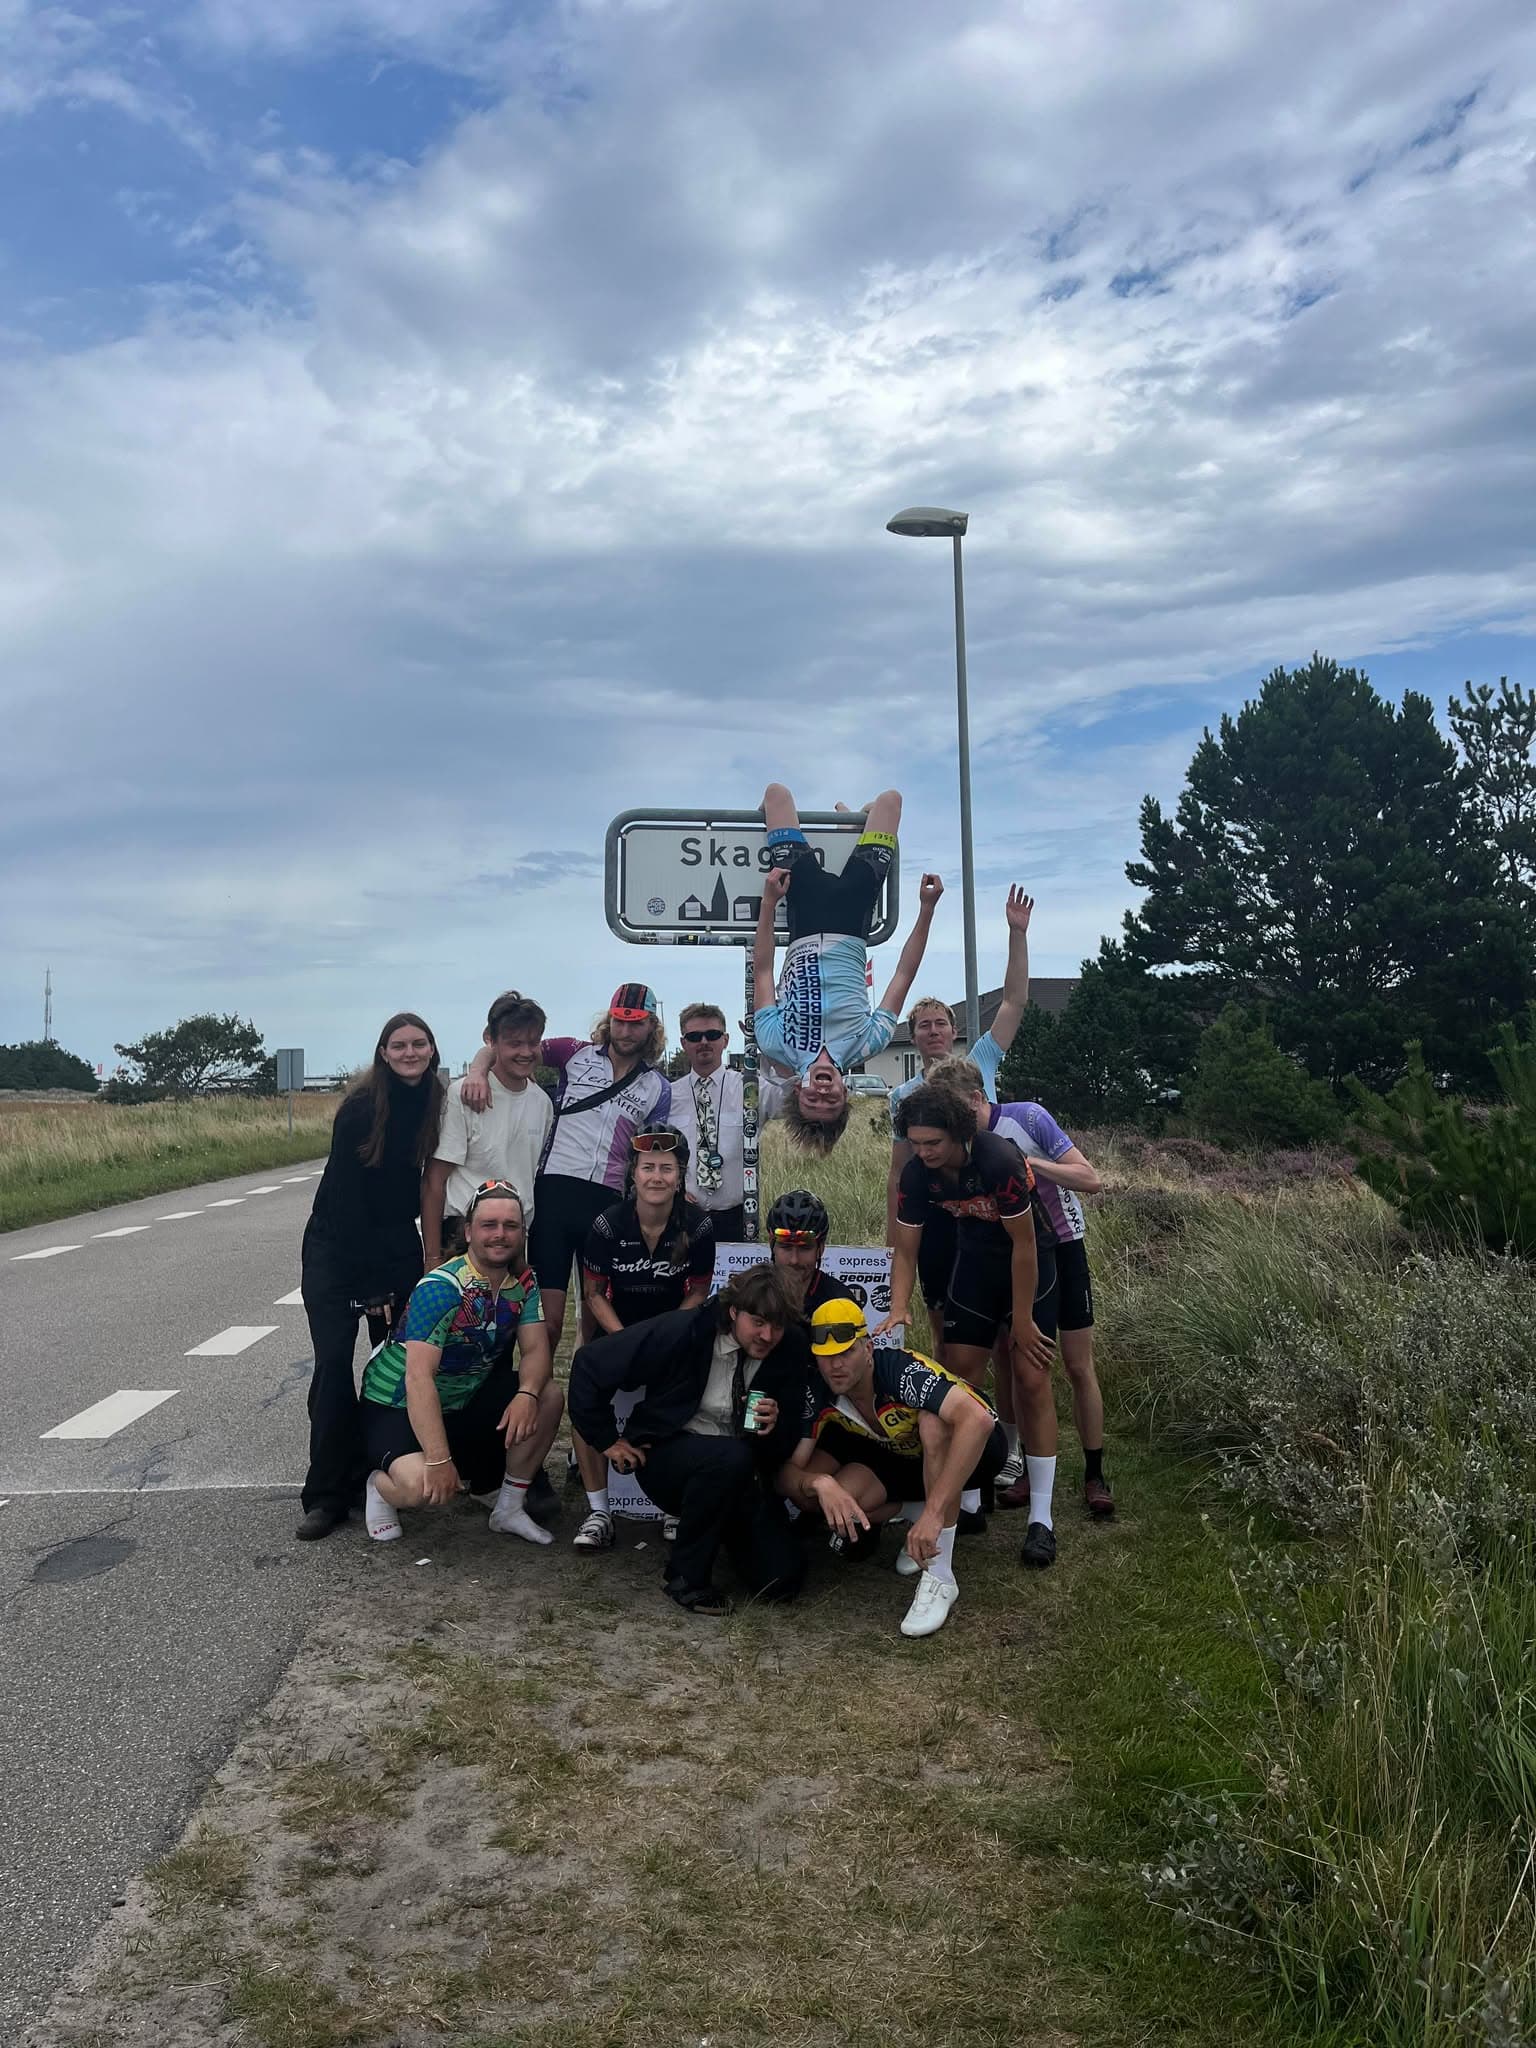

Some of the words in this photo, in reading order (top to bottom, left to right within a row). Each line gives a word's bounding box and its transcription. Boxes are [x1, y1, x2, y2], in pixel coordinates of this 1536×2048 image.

[680, 837, 825, 873] Skagn
[728, 1255, 770, 1267] expres
[839, 1256, 887, 1268] express
[839, 1272, 887, 1283] geopal
[871, 1289, 891, 1301] Sort
[607, 1496, 651, 1508] expres
